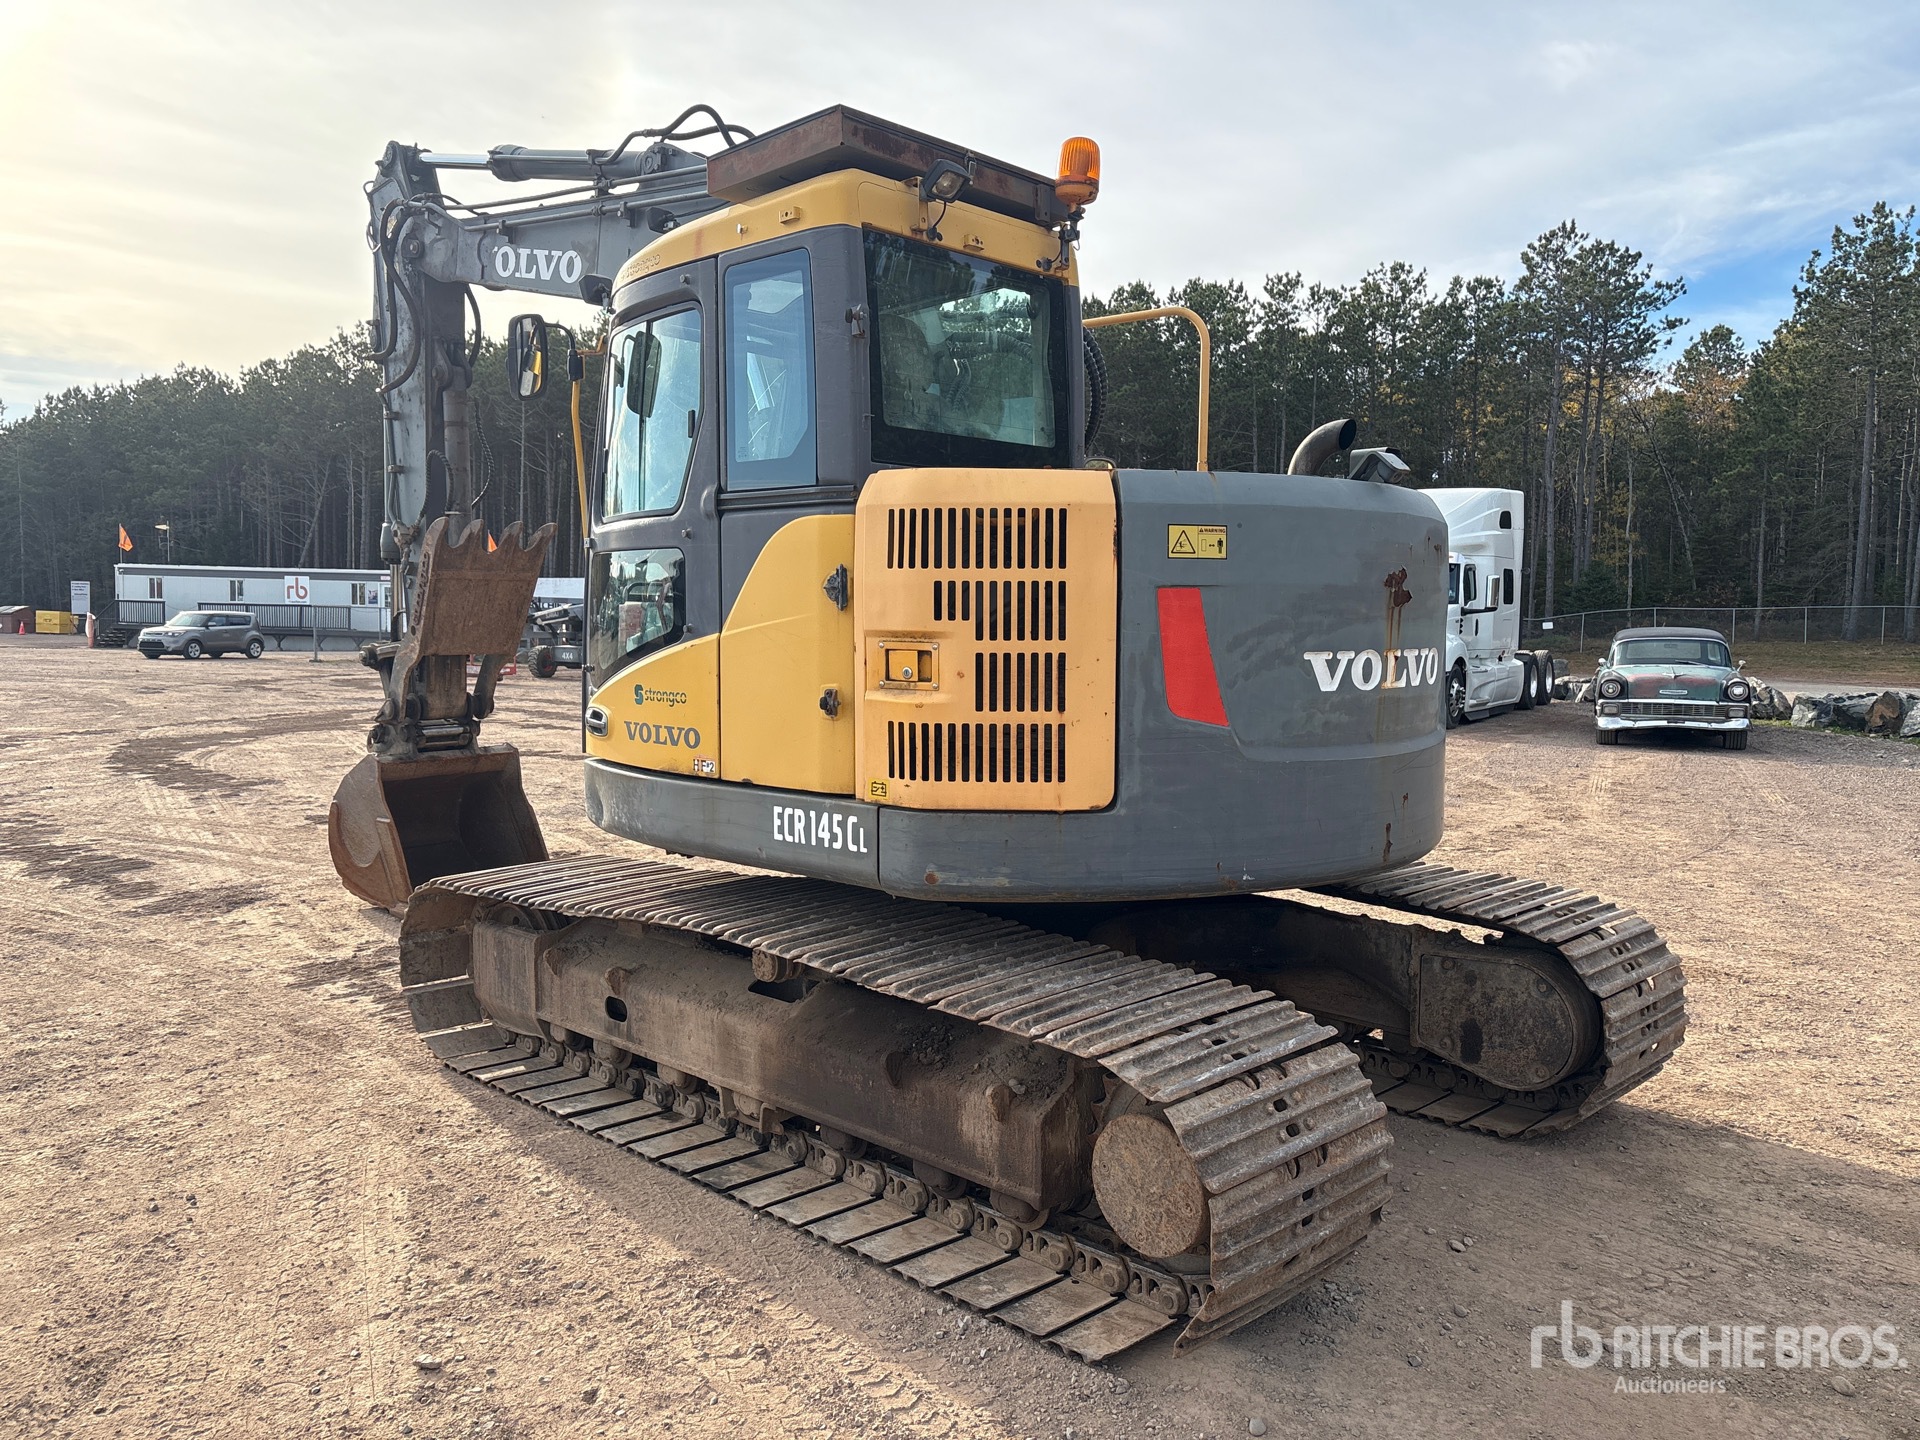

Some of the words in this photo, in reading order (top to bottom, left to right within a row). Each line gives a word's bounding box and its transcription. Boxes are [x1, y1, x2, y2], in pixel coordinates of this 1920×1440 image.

[492, 246, 582, 284] OLVO
[287, 577, 308, 600] rb
[1303, 647, 1439, 692] VOLVO
[645, 687, 687, 707] strongco
[624, 720, 701, 749] VOLVO
